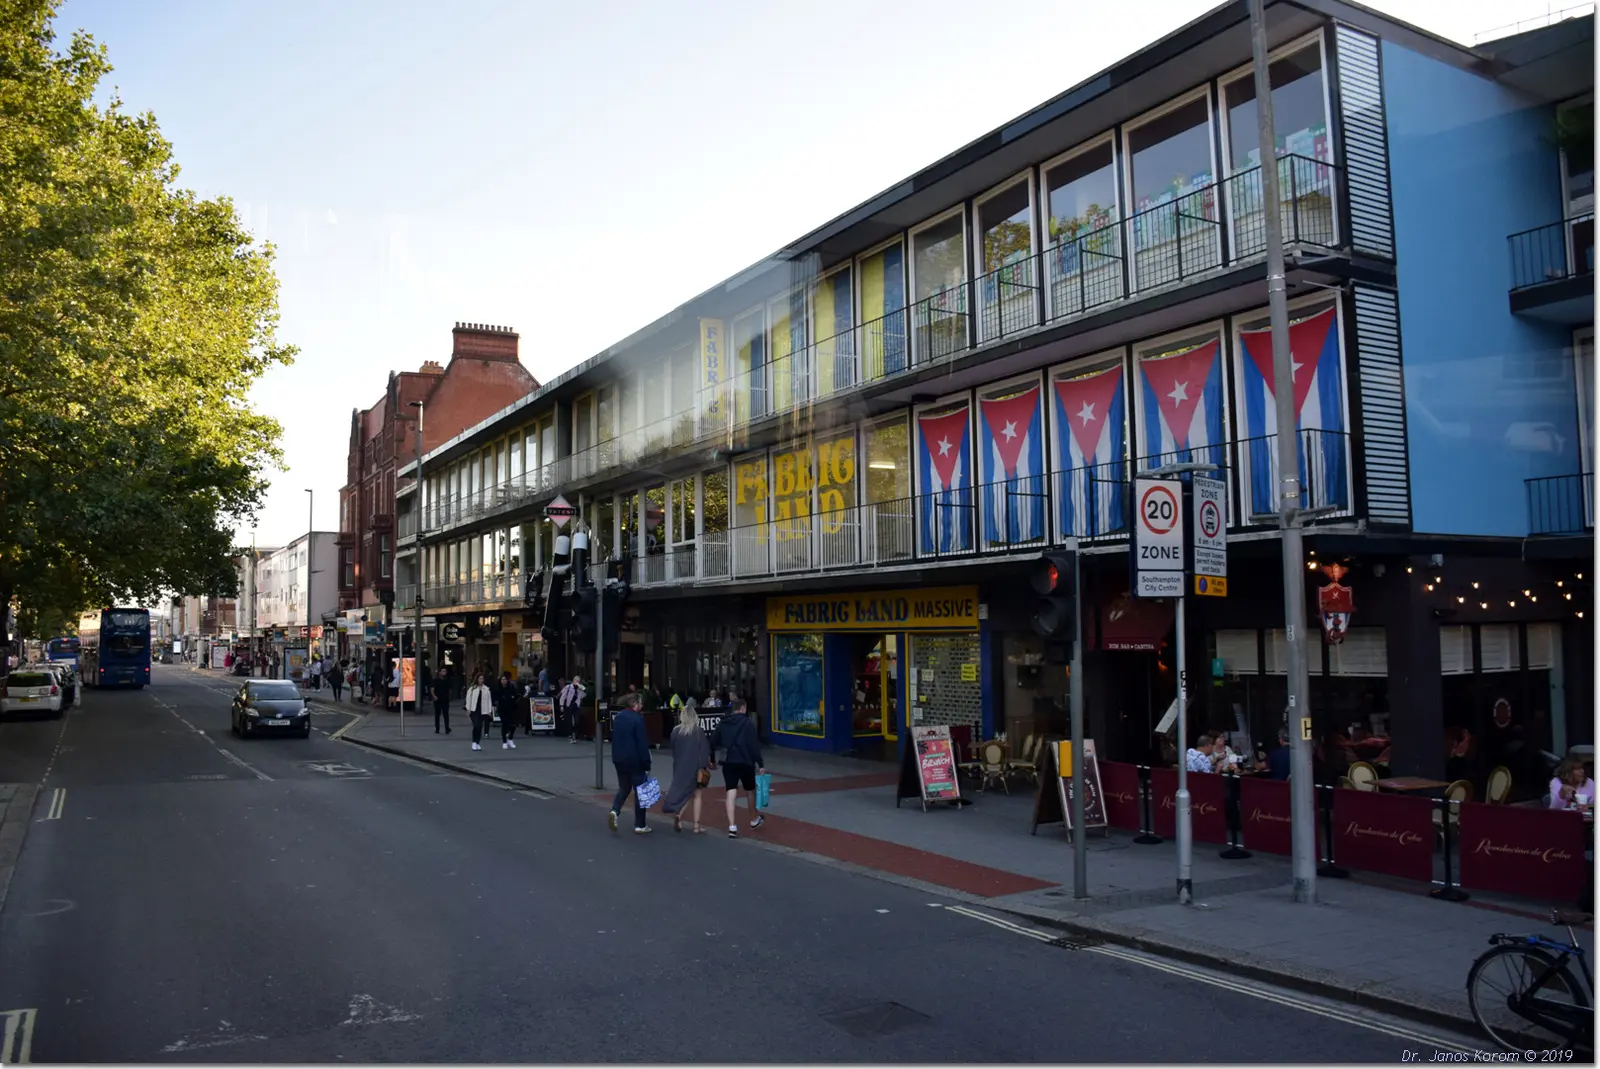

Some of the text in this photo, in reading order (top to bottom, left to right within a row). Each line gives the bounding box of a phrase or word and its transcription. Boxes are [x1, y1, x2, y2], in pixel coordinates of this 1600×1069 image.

[1195, 477, 1225, 490] PEDESTRIAN
[1201, 488, 1218, 500] ZONE
[1147, 500, 1172, 520] 20
[1141, 546, 1179, 559] ZONE
[1141, 575, 1181, 584] Southampton
[1145, 584, 1178, 592] City Centre
[855, 598, 909, 622] LAND
[914, 599, 973, 618] MASSIVE
[1399, 830, 1423, 845] Cuba
[1530, 847, 1541, 856] de
[1542, 847, 1571, 862] Cuba
